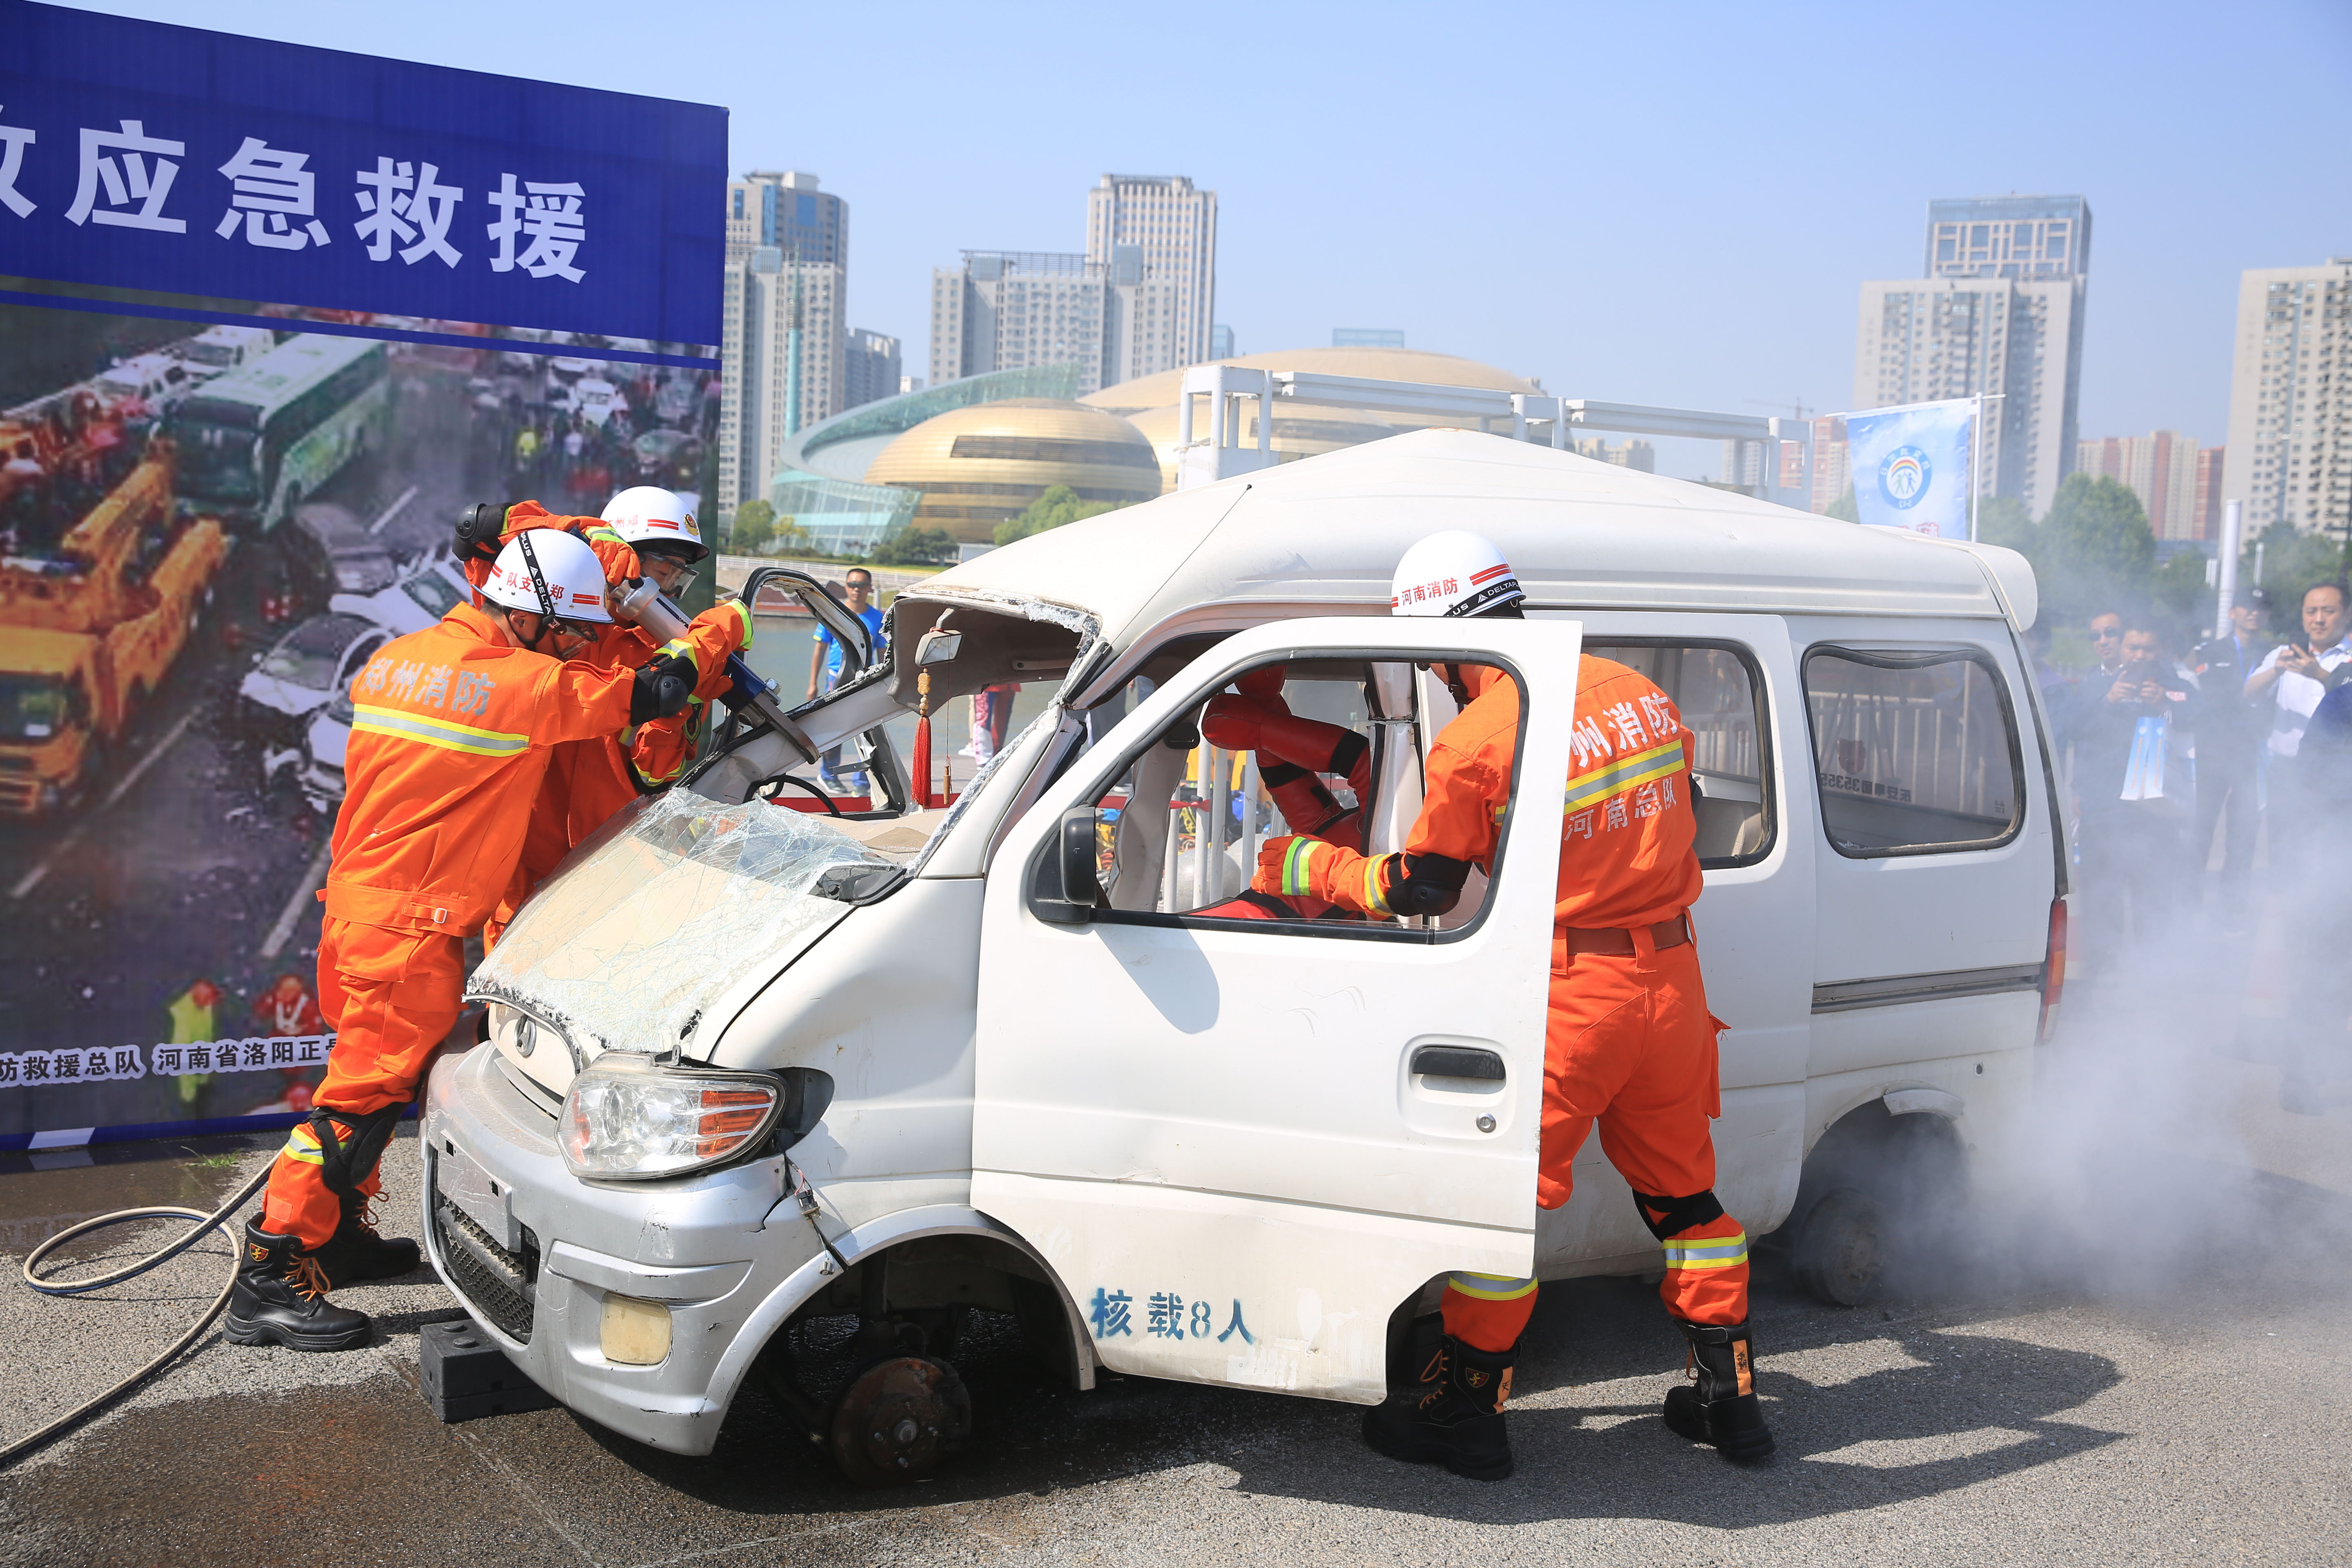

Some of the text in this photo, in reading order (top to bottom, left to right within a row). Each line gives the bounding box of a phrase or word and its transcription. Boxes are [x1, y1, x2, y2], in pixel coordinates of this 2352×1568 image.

[1401, 577, 1458, 606] 河南消防
[1487, 581, 1519, 597] DELTAPL
[360, 657, 495, 716] 郑州消防
[1564, 777, 1677, 841] 河南总队
[1089, 1287, 1254, 1346] 核载8人
